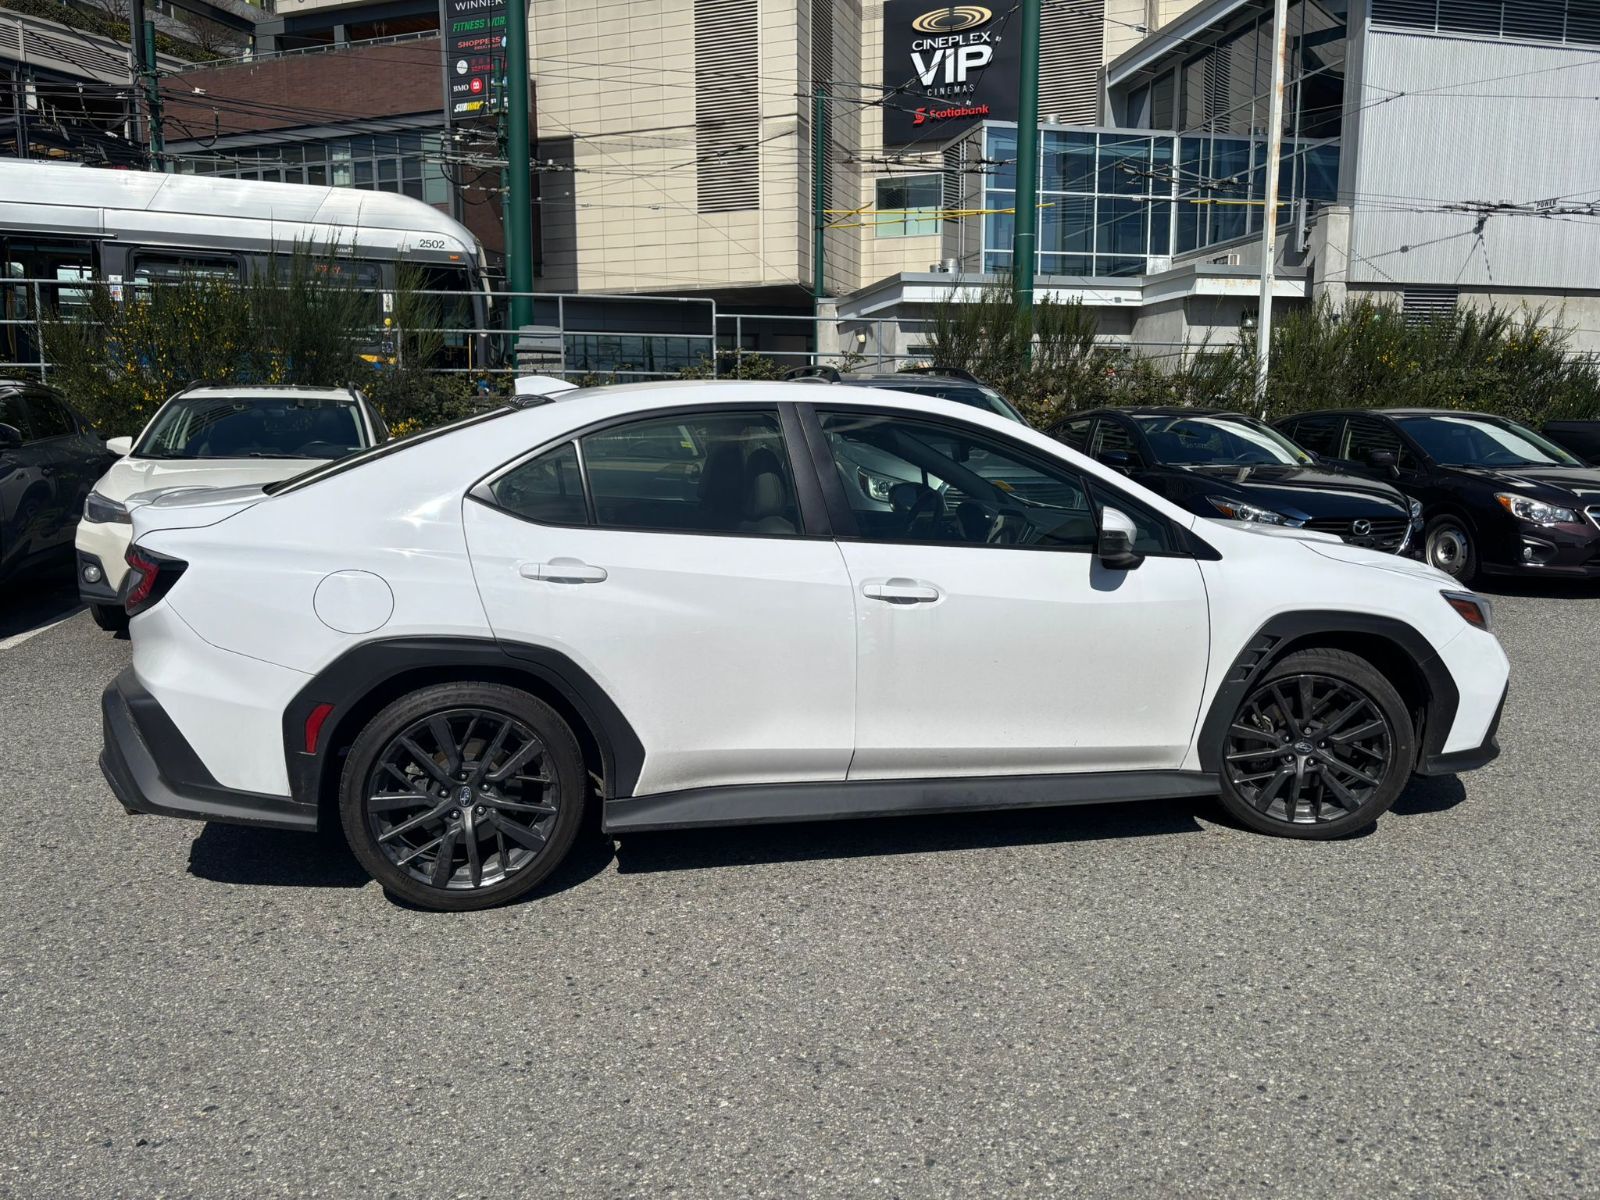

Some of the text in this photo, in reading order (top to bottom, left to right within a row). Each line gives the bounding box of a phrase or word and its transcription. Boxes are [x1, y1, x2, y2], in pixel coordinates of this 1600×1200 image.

[455, 0, 506, 11] WINNER
[453, 19, 485, 32] FITNESS
[911, 31, 991, 51] CINEPLEX
[910, 44, 993, 86] VIP
[453, 84, 469, 92] BMO
[927, 83, 975, 97] CINEMAS
[929, 104, 989, 119] Scotiabank
[419, 238, 445, 249] 2502
